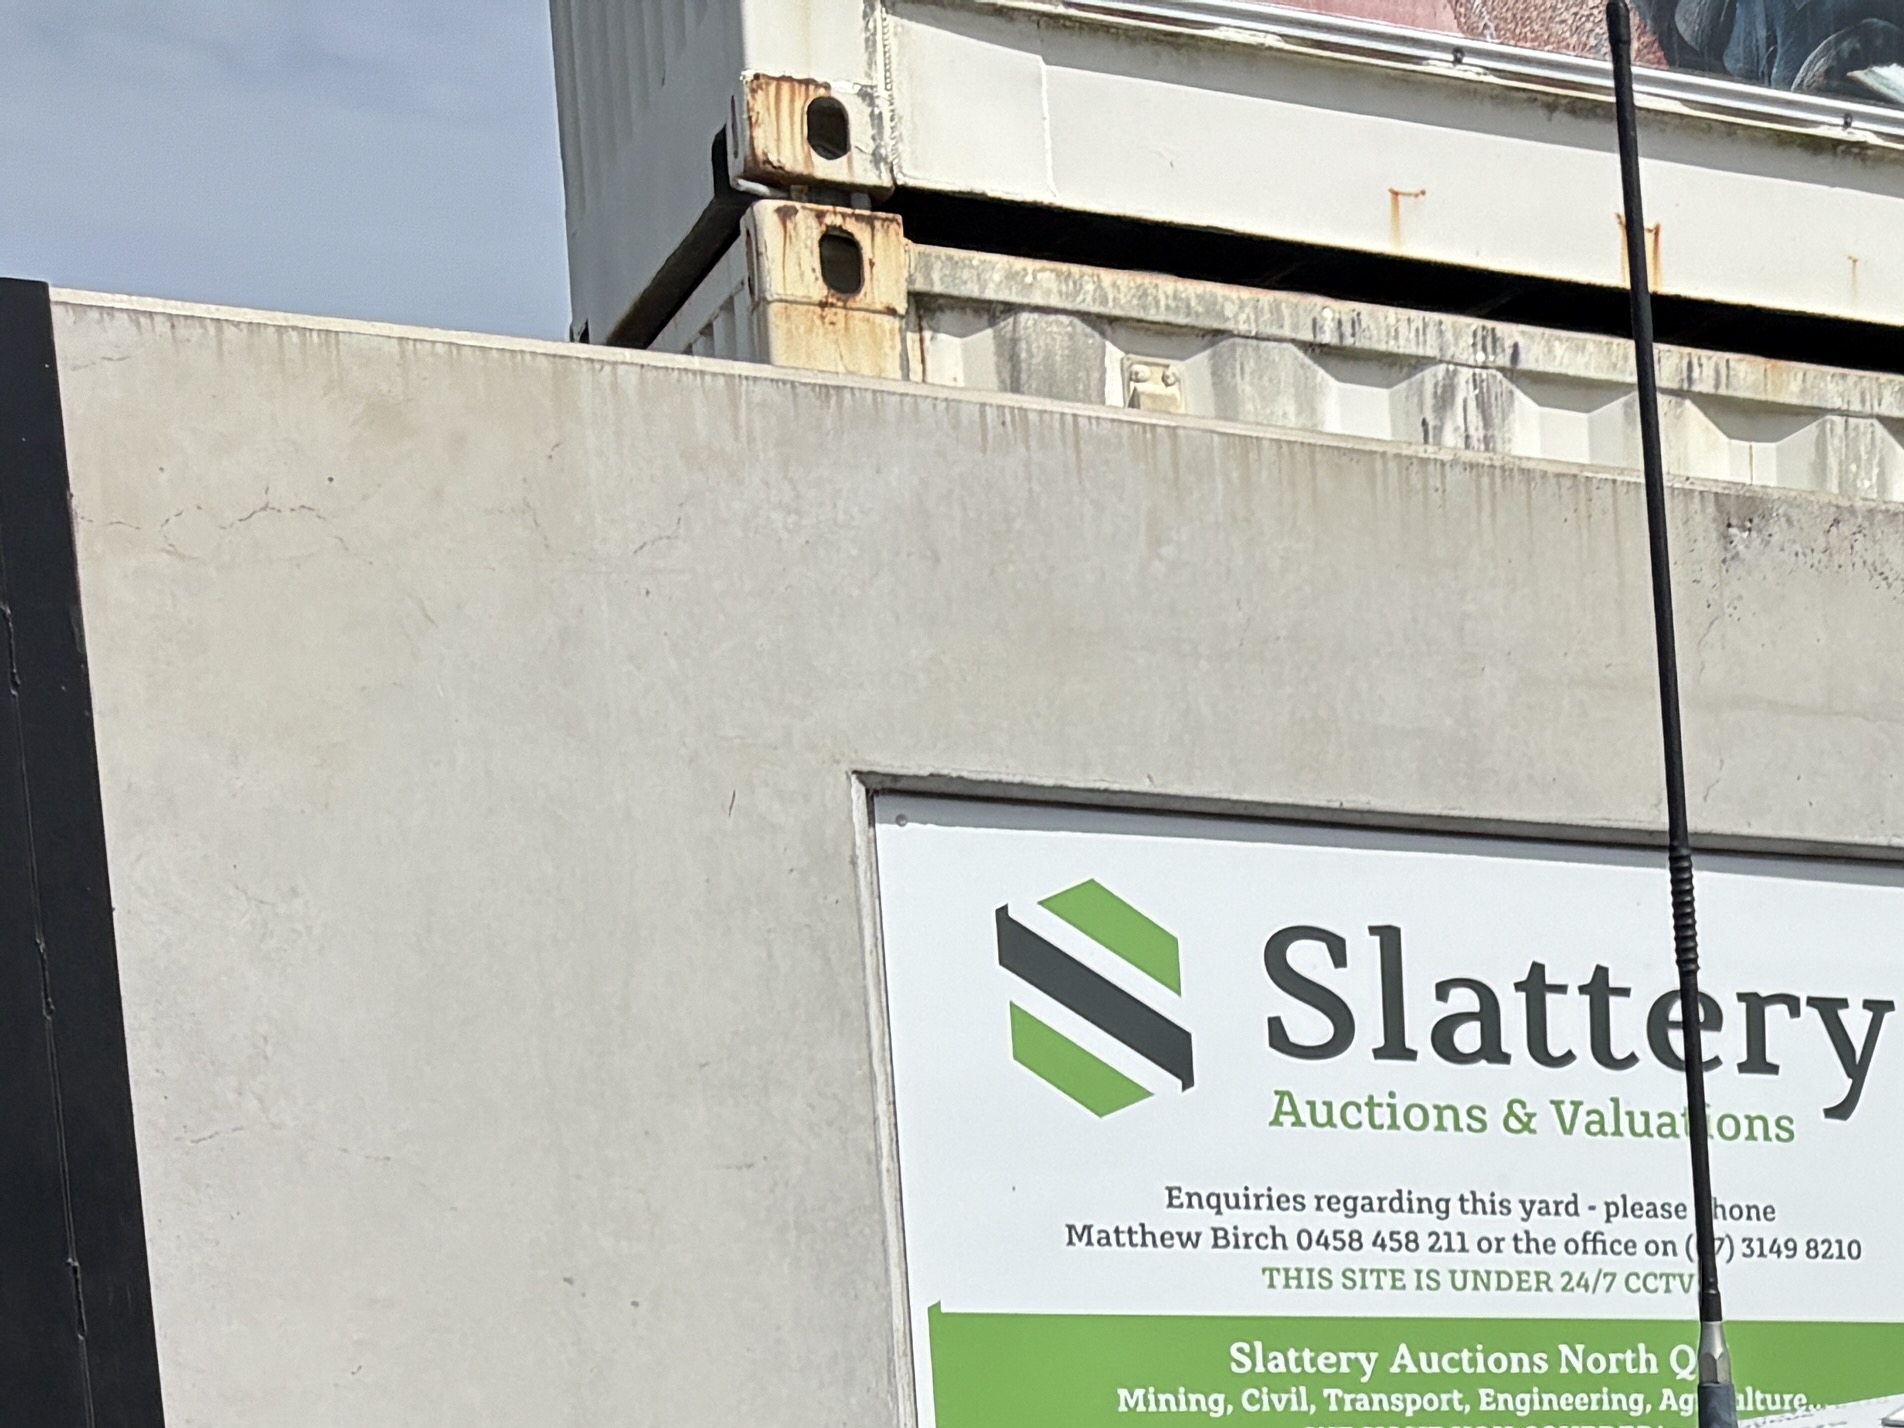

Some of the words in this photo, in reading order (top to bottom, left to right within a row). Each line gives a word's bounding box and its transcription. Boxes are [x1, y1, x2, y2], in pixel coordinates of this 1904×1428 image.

[1262, 923, 1897, 1122] Slattery
[1268, 1089, 1489, 1136] Auctions
[1502, 1097, 1538, 1135] &
[1550, 1097, 1796, 1143] Valuaons
[1164, 1186, 1307, 1216] Enquiries
[1313, 1188, 1452, 1220] regarding
[1458, 1190, 1513, 1217] this
[1518, 1192, 1581, 1223] yard
[1603, 1193, 1688, 1224] please
[1712, 1196, 1777, 1223] hone
[1064, 1222, 1202, 1249] Matthew
[1210, 1225, 1289, 1251] Birch
[1296, 1228, 1364, 1252] 0458
[1371, 1229, 1420, 1253] 458
[1427, 1230, 1470, 1254] 211
[1476, 1235, 1506, 1254] or
[1512, 1229, 1557, 1255] the
[1563, 1230, 1638, 1257] office
[1644, 1238, 1679, 1257] on
[1684, 1232, 1736, 1264] (7)
[1741, 1237, 1799, 1260] 3149
[1804, 1238, 1863, 1261] 8210
[1261, 1266, 1334, 1290] THIS
[1341, 1267, 1407, 1291] SITE
[1414, 1268, 1442, 1292] IS
[1448, 1269, 1554, 1293] UNDER
[1560, 1269, 1618, 1296] 24/7
[1624, 1271, 1696, 1295] CCTV
[1229, 1340, 1379, 1383] Slattery
[1389, 1342, 1549, 1375] Auctions
[1558, 1342, 1659, 1375] North
[1117, 1386, 1234, 1418] Mining,
[1241, 1385, 1316, 1415] Civil,
[1323, 1387, 1471, 1417] Transport,
[1478, 1386, 1652, 1417] Engineering,
